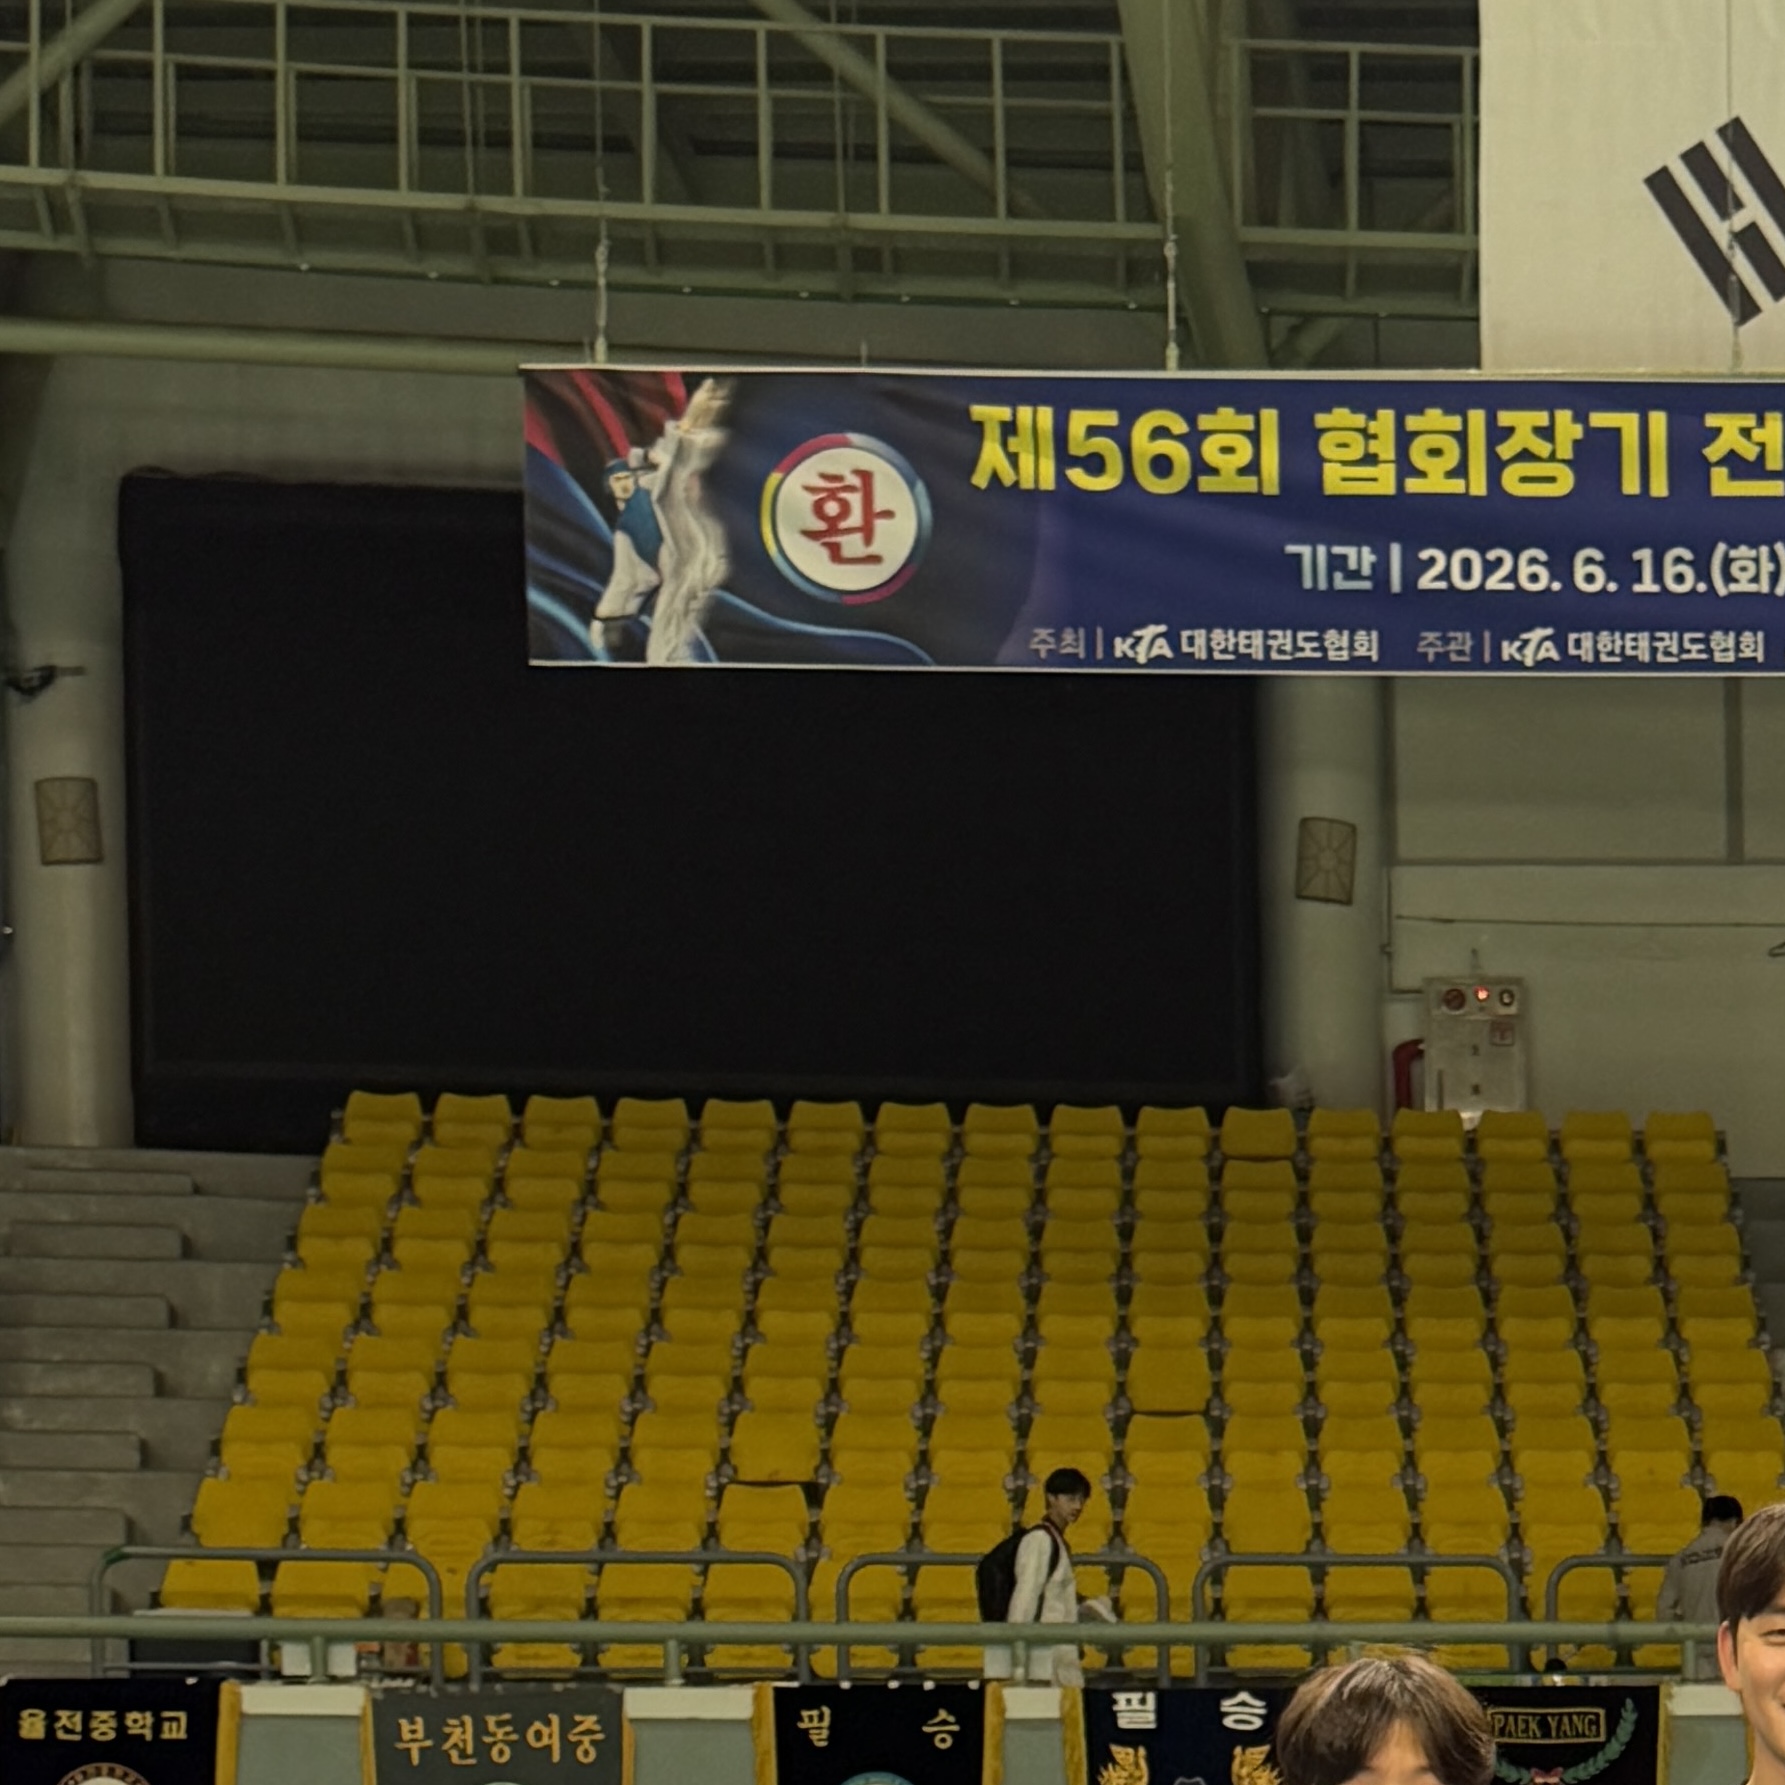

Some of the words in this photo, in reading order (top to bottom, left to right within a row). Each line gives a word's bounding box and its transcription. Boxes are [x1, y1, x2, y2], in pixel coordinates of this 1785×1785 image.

[970, 404, 1281, 496] 제56회
[1314, 407, 1669, 497] 협회장기
[799, 468, 895, 566] 환
[1284, 543, 1375, 592] 기간
[1416, 544, 1562, 592] 2026.
[1573, 544, 1619, 593] 6.
[1029, 627, 1086, 656] 주최
[1113, 623, 1175, 663] KTA
[1181, 630, 1380, 662] 대한태권도협회
[1416, 632, 1474, 660] 주관
[1501, 627, 1561, 667] KTA
[1568, 630, 1765, 664] 대한태권도협회
[797, 1705, 832, 1747] 필
[921, 1708, 961, 1750] 승
[1111, 1691, 1158, 1730] 필
[1220, 1691, 1269, 1731] 승
[1494, 1713, 1542, 1738] PAEK
[1547, 1714, 1598, 1738] YANG
[394, 1713, 606, 1766] 부천동여중
